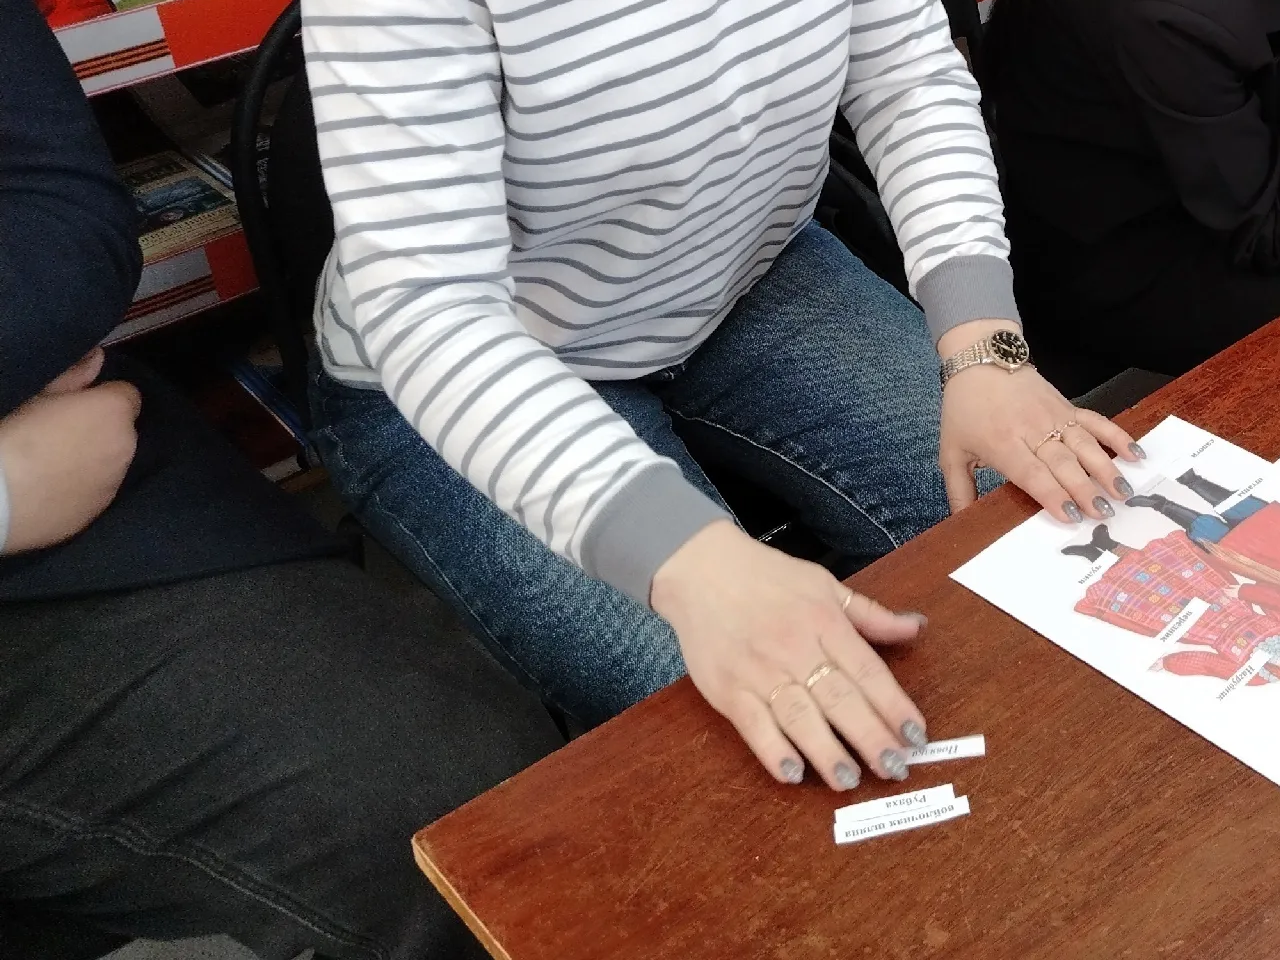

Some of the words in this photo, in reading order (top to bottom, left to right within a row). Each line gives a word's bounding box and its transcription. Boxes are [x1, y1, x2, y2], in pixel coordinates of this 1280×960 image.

[885, 793, 927, 808] Рубаха
[889, 804, 955, 827] войлочная
[844, 821, 886, 838] шляпа
